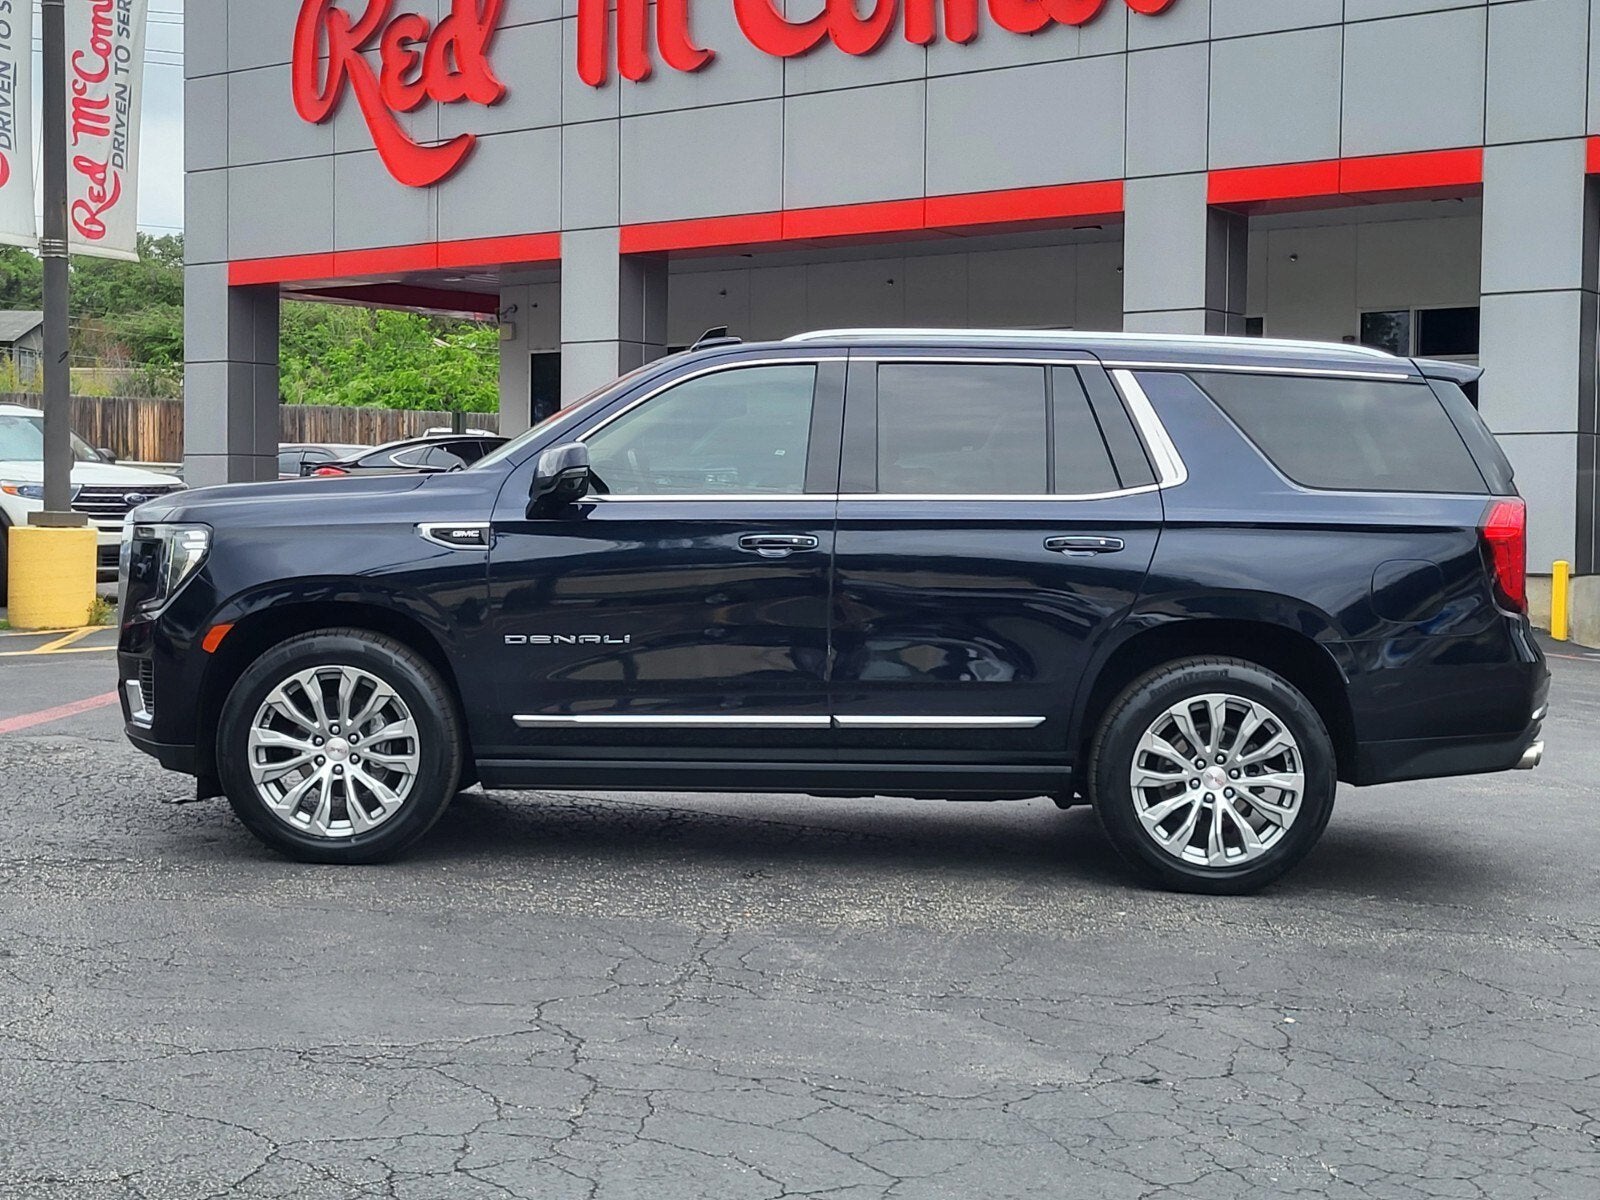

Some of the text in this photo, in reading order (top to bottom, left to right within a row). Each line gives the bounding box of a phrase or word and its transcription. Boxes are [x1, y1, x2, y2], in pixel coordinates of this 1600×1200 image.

[114, 44, 131, 75] TO
[292, 0, 506, 188] Red
[0, 60, 12, 150] DRIVEN
[71, 0, 121, 240] Red McCom
[112, 84, 128, 170] DRIVEN
[452, 530, 480, 538] GMC
[504, 634, 631, 644] DENALI
